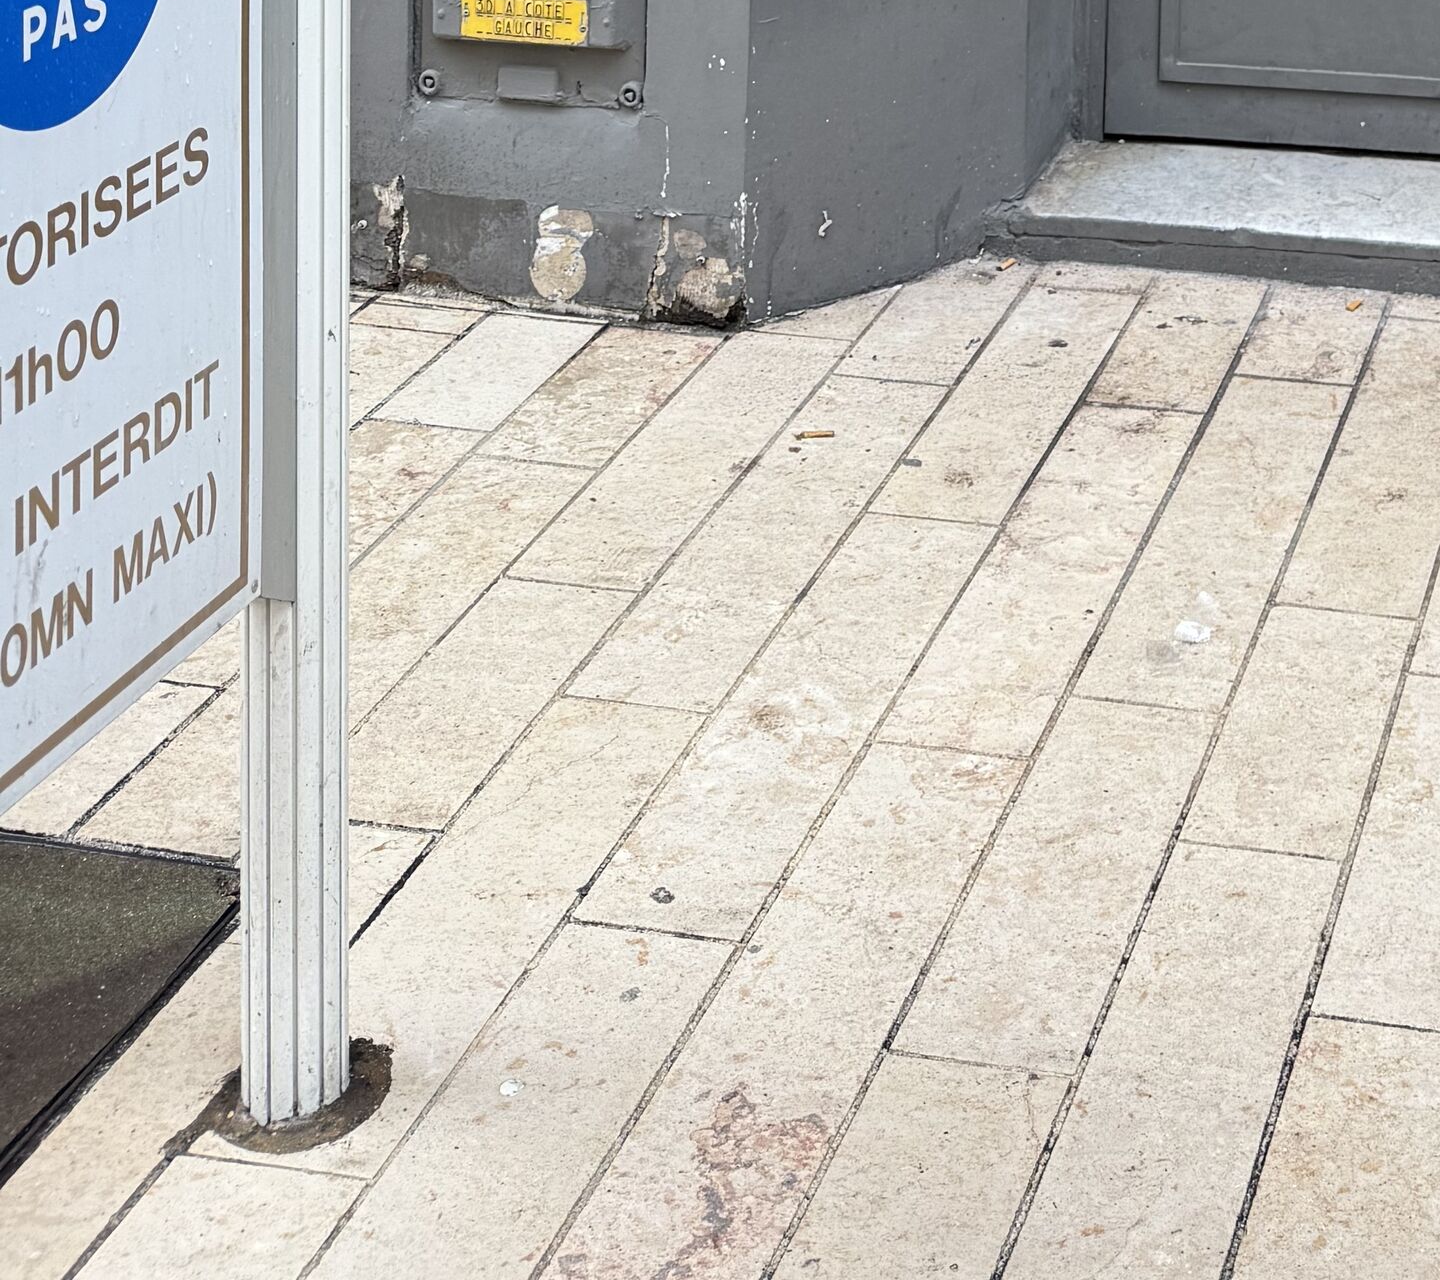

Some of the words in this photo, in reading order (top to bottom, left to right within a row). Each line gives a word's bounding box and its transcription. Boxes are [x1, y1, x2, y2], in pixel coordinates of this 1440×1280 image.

[495, 20, 552, 38] GAUCHE
[505, 1, 513, 15] A
[525, 2, 564, 19] COTE
[0, 127, 209, 286] ORISEES
[0, 299, 120, 425] 1h00
[15, 359, 220, 557] INTERDIT
[113, 471, 217, 604] MAXI)
